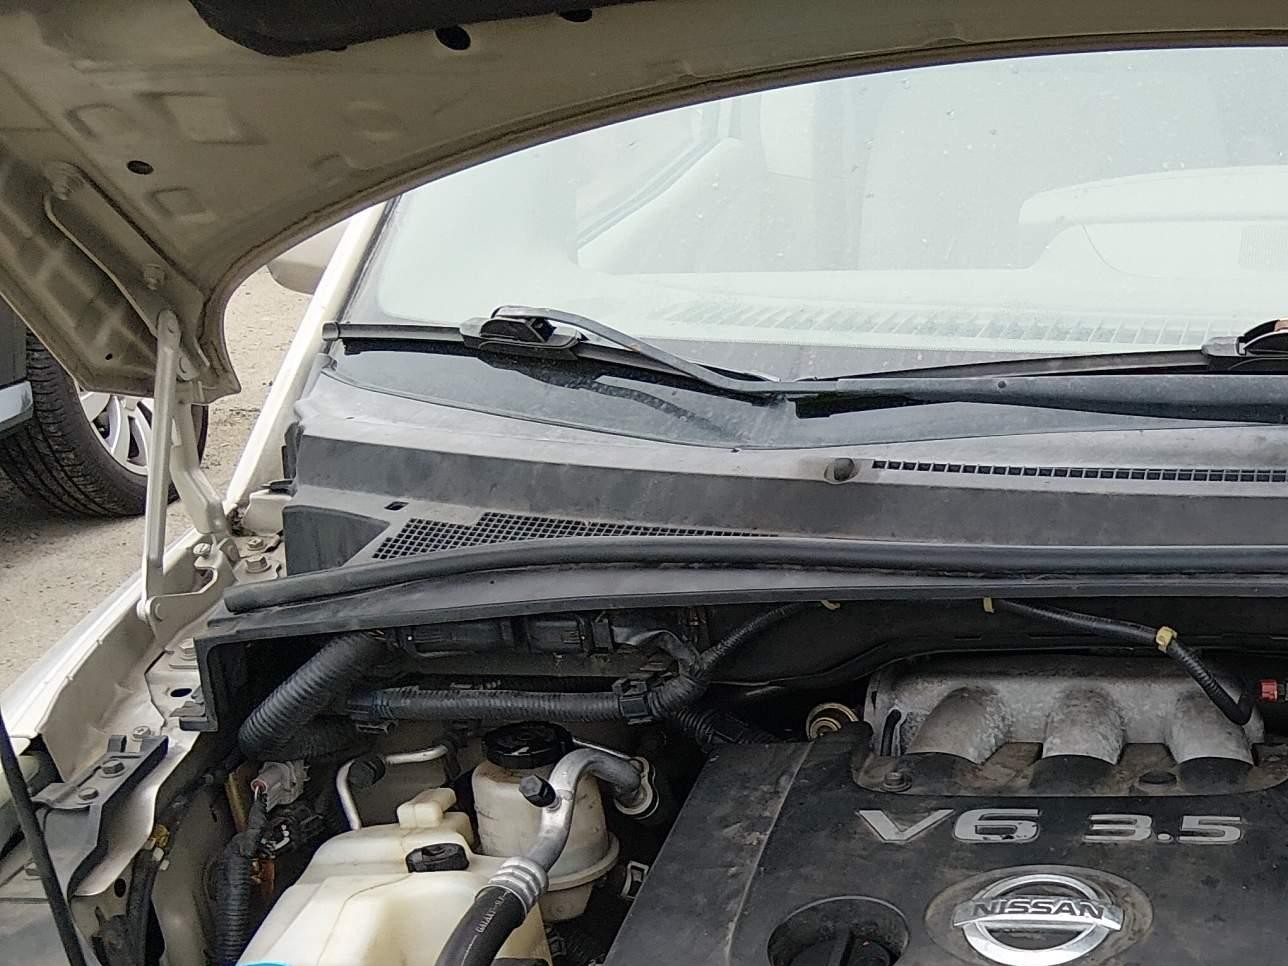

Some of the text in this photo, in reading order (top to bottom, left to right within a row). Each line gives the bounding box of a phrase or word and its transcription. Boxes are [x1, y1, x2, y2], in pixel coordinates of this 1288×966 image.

[856, 808, 1243, 845] V6 3.5
[972, 898, 1104, 920] NISSAN
